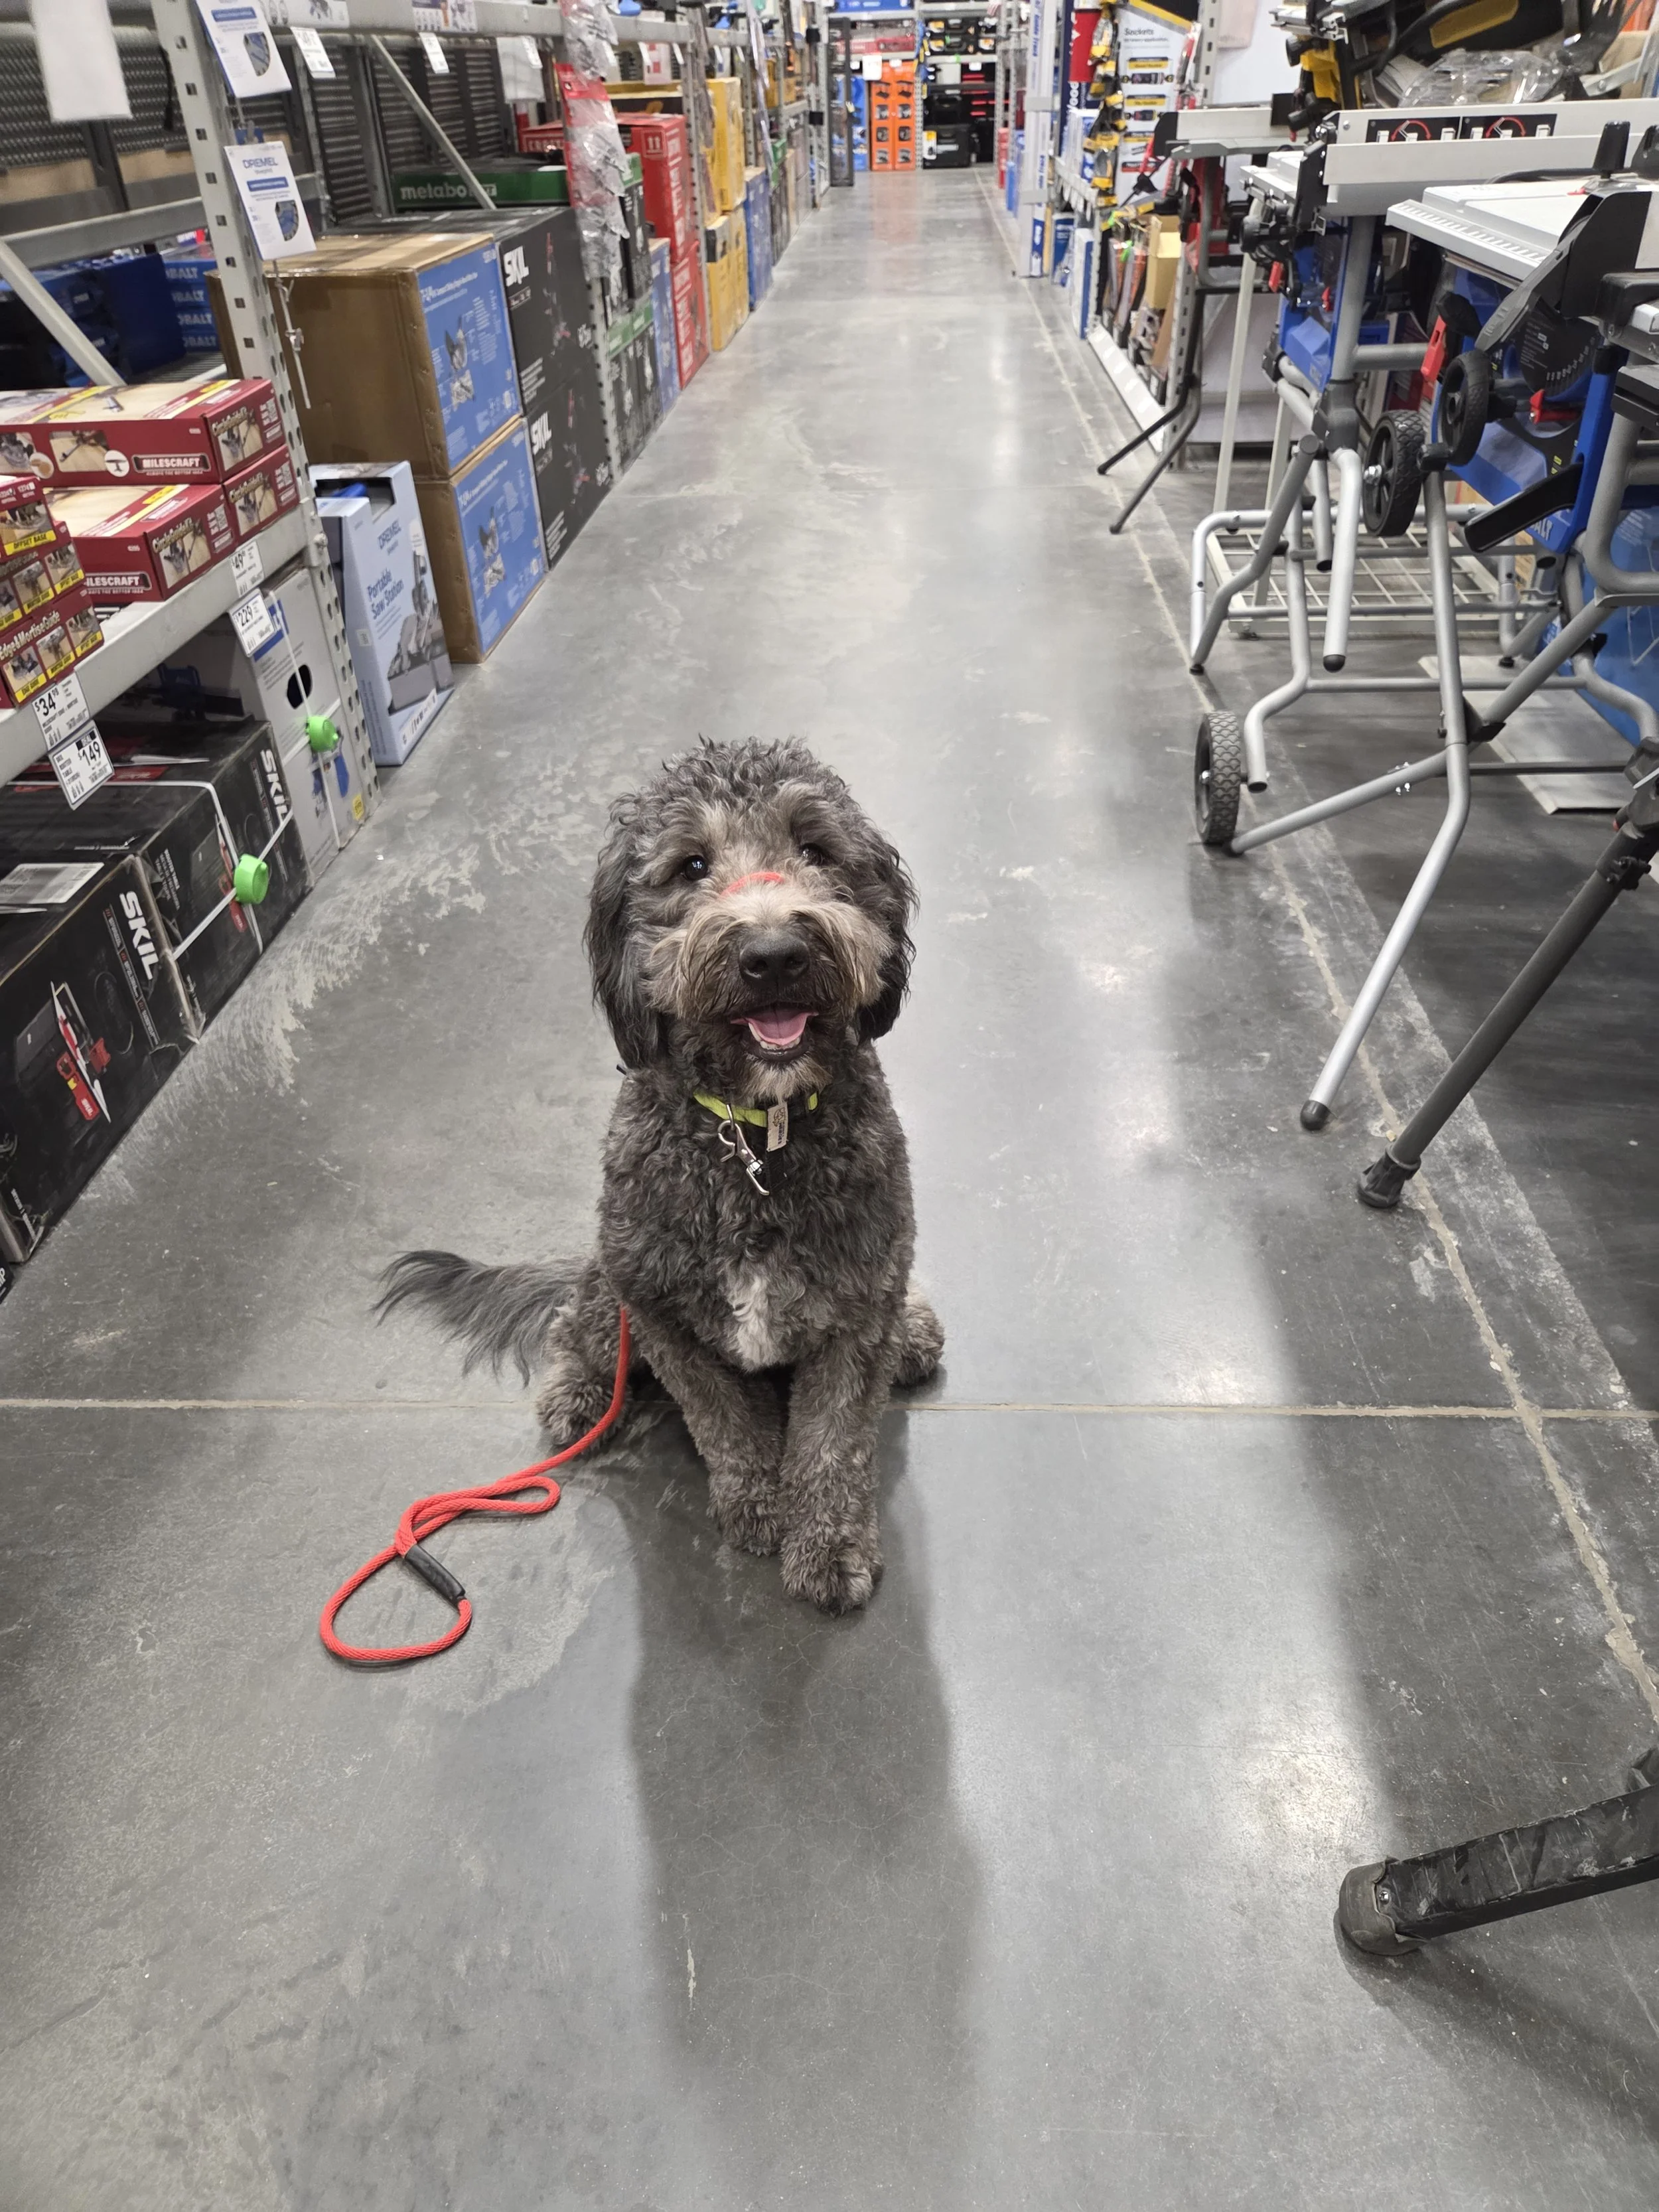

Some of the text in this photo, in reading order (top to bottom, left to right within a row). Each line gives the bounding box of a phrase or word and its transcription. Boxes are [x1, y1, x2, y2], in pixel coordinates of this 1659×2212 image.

[242, 157, 279, 169] DREMEL
[399, 183, 467, 200] metabo
[166, 267, 198, 279] BALT
[504, 246, 529, 287] SKIL
[171, 289, 204, 302] BALT
[177, 313, 212, 325] BALT
[182, 336, 216, 348] BALT
[531, 411, 552, 455] SKIL
[142, 457, 200, 469] MILESCRAFT
[13, 533, 47, 550] OFFSET BASE
[378, 521, 402, 550] DREMEL
[84, 576, 139, 587] ILESCRAFT
[367, 567, 394, 602] Portable
[372, 598, 387, 620] Saw
[385, 579, 405, 605] Station
[35, 692, 56, 716] $34
[78, 741, 102, 767] $149
[260, 749, 288, 824] SKIL
[119, 891, 159, 981] SKIL
[81, 1098, 94, 1117] SKIL
